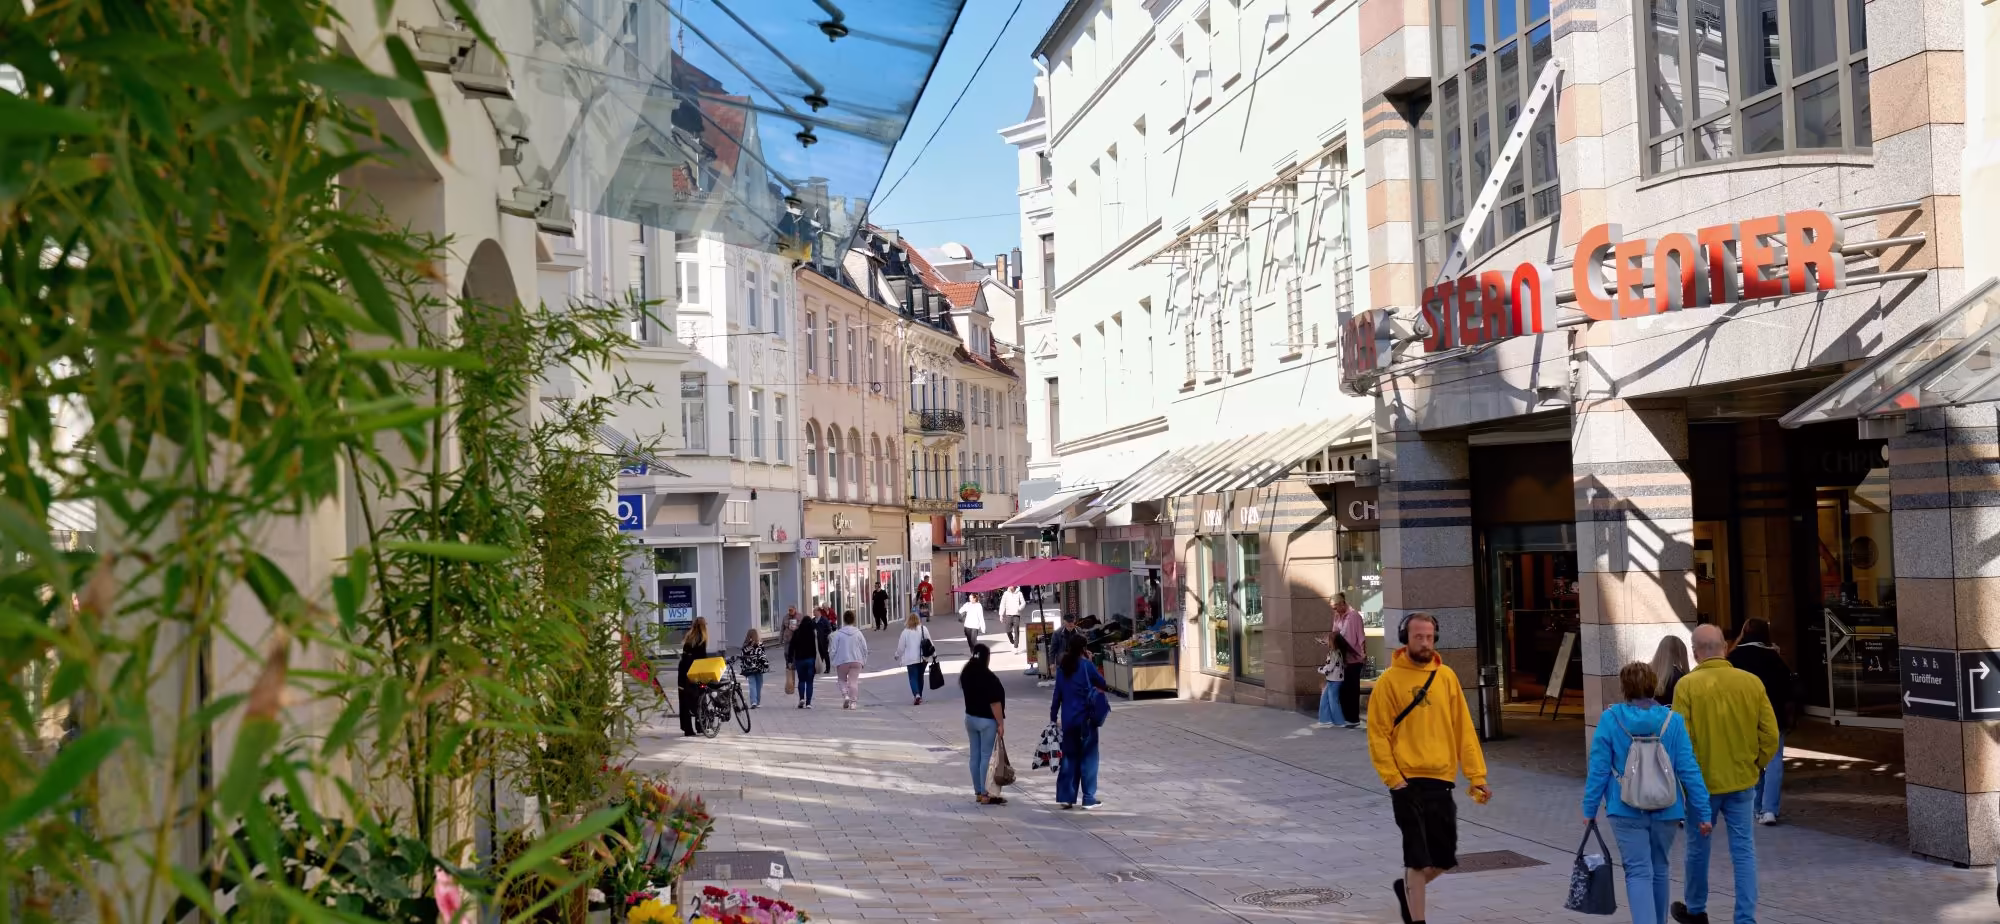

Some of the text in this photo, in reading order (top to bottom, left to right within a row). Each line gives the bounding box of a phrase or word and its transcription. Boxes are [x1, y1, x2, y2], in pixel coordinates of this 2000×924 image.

[1423, 261, 1556, 353] STERN
[1573, 209, 1845, 321] CENTER
[668, 608, 688, 619] WSP
[1910, 673, 1943, 685] Türöffner
